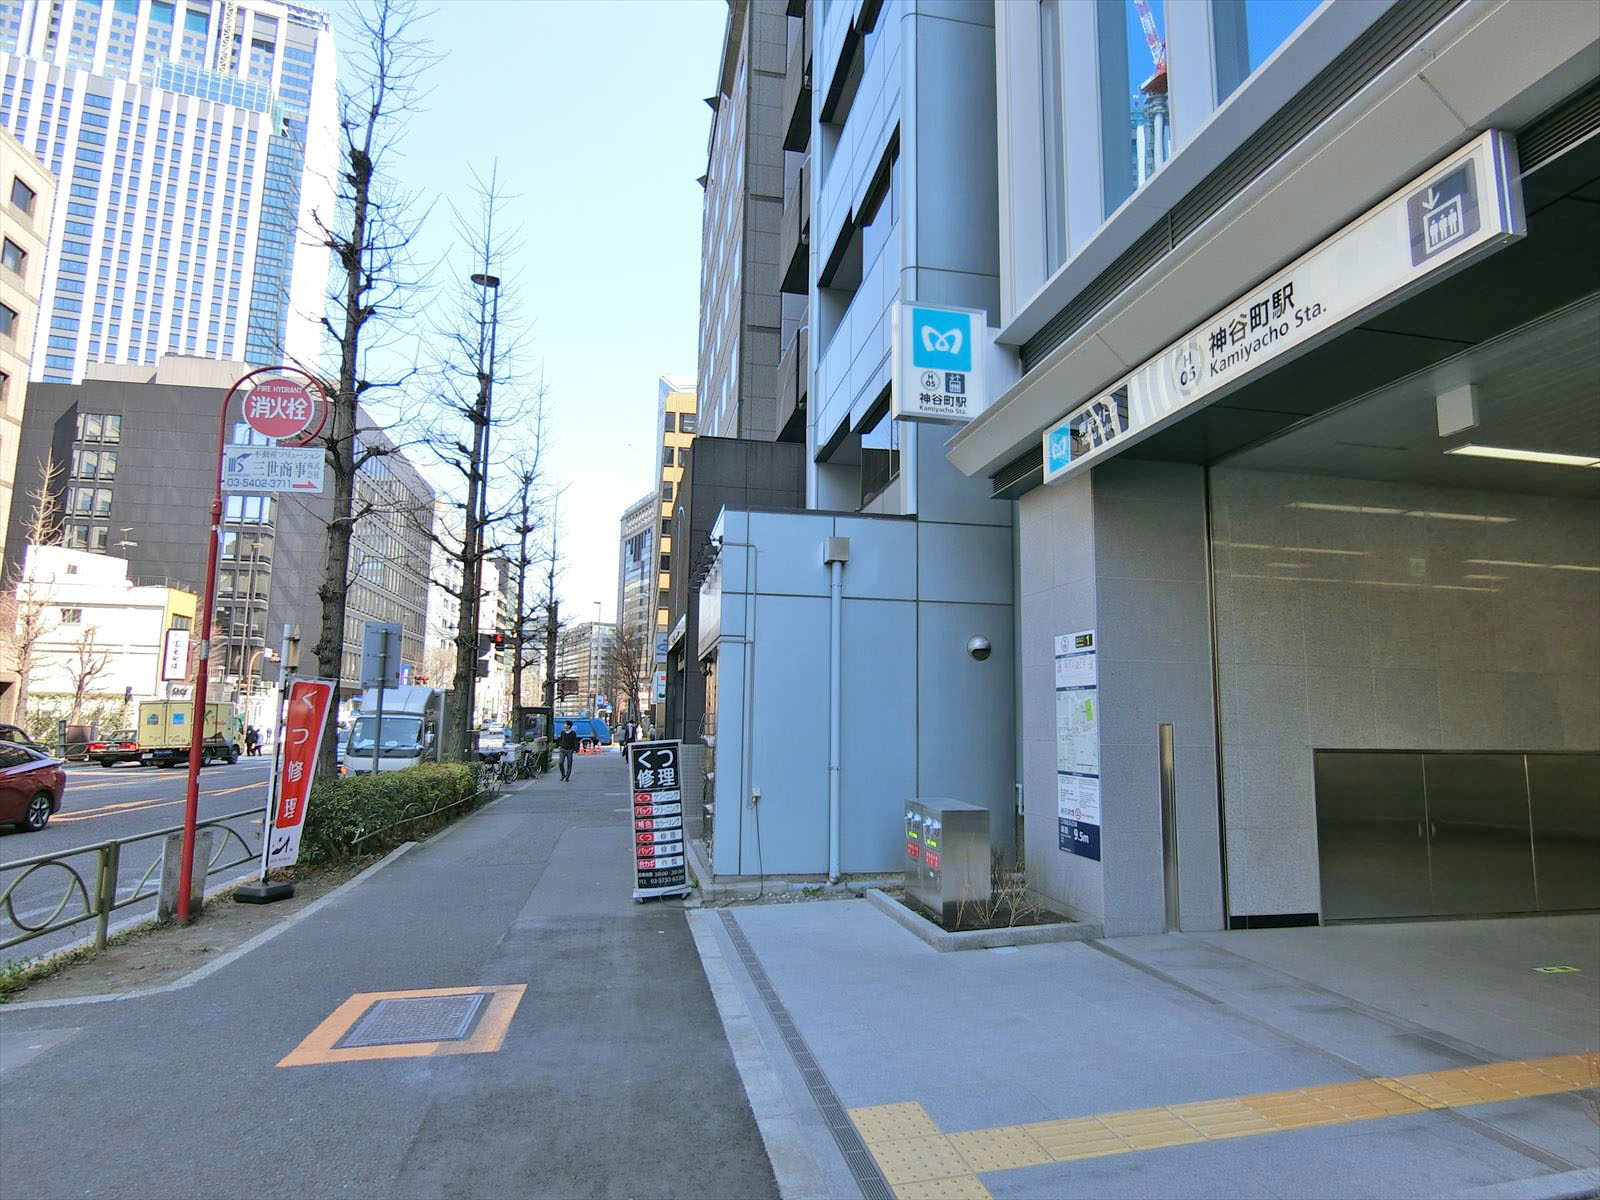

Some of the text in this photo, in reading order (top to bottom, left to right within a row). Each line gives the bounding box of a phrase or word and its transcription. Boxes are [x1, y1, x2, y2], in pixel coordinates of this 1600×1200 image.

[1208, 281, 1295, 358] 神谷町駅
[1210, 303, 1327, 377] Kamiyacho Sta.
[1180, 365, 1196, 386] 05
[273, 386, 303, 394] HYDRANT
[250, 396, 308, 420] 消火栓
[919, 393, 967, 408] 神谷町駅
[919, 405, 954, 414] Kamiyacho
[252, 460, 306, 478] 三世商事
[227, 478, 291, 488] 03-5402-3711
[284, 690, 318, 819] くつ修理
[638, 749, 674, 768] くつ
[636, 767, 675, 788] 修理
[637, 794, 651, 802] くつ
[639, 833, 653, 841] くつ
[1074, 828, 1090, 844] 9.5m
